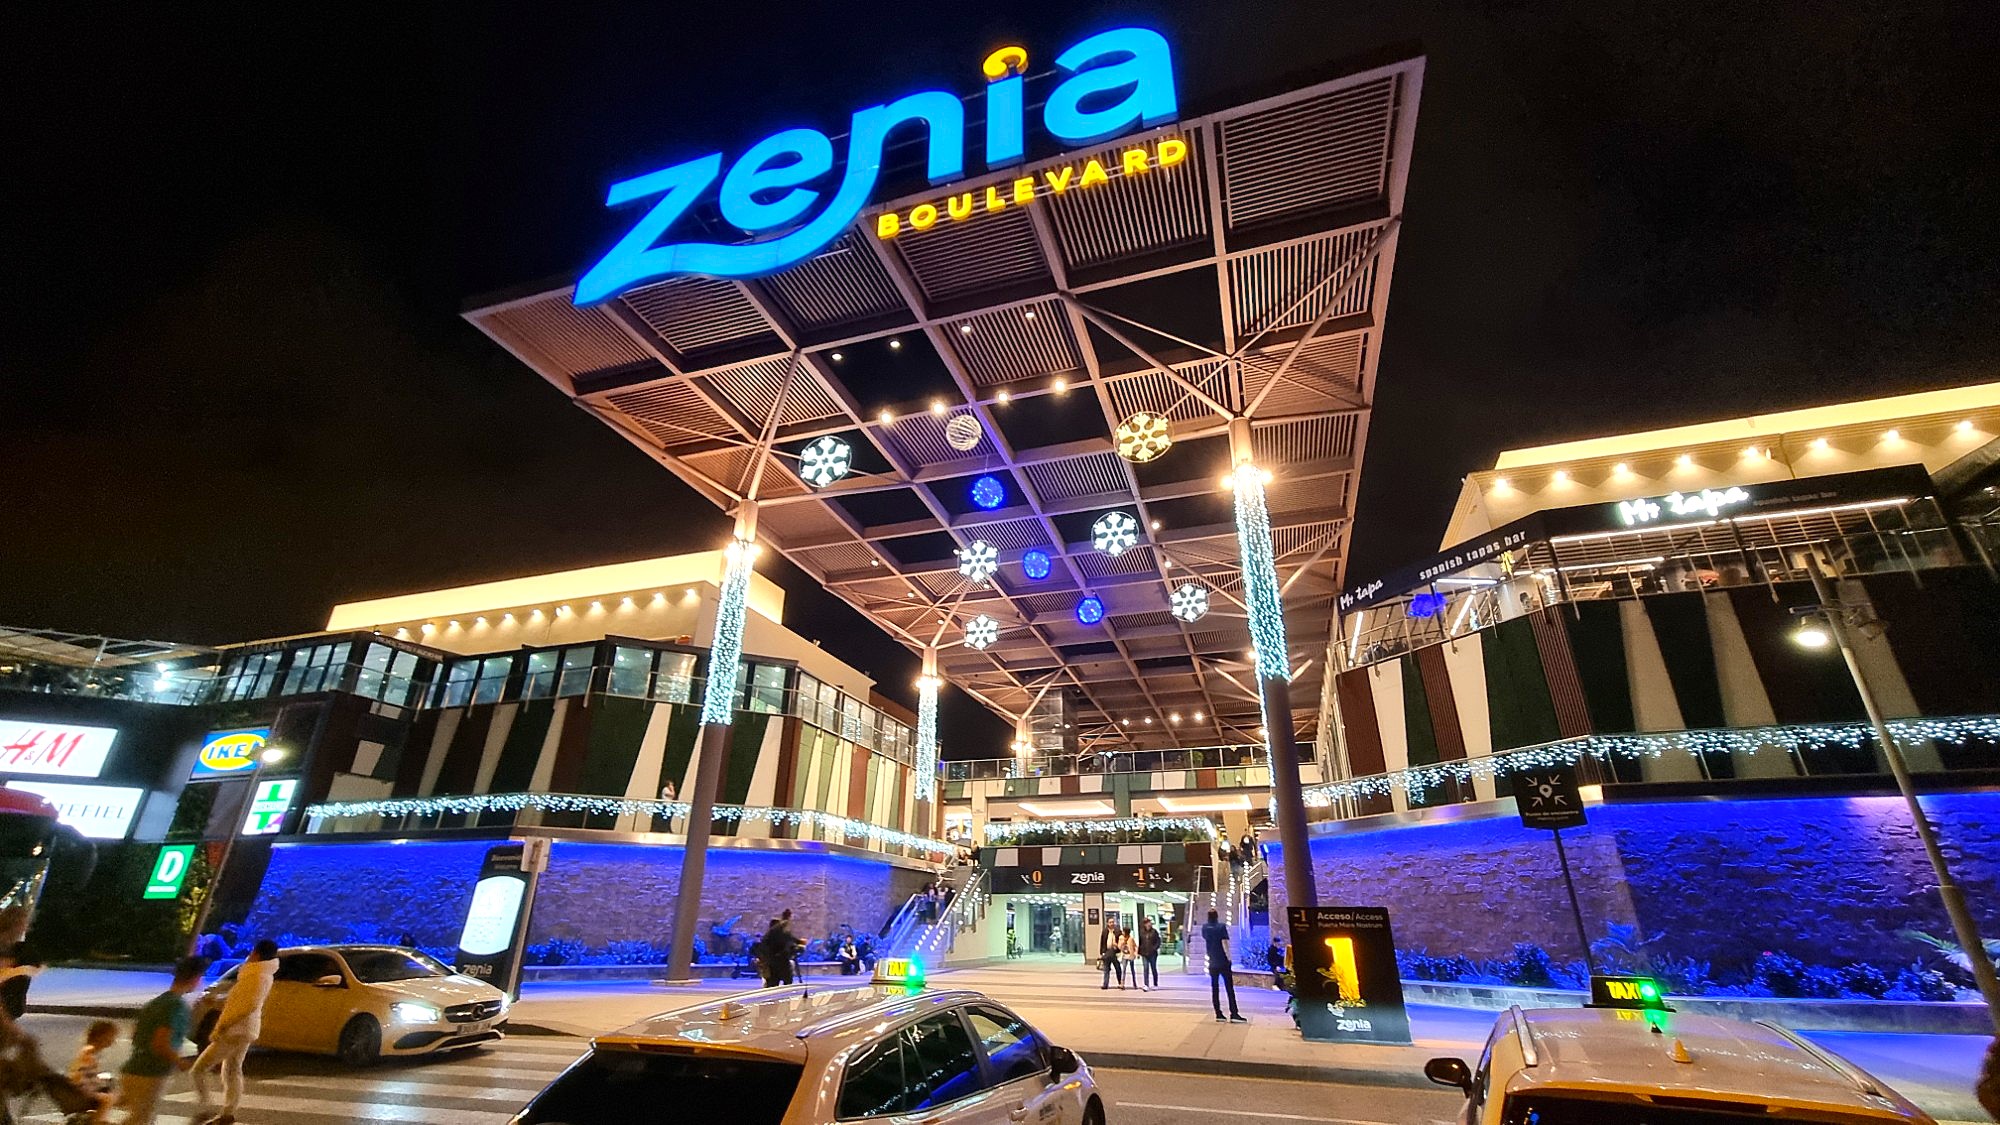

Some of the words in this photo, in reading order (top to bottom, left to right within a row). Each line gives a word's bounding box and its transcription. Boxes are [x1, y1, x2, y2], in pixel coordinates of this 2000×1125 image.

[572, 27, 1178, 305] zenia
[876, 139, 1188, 240] BOULEVARD
[1619, 499, 1660, 525] Mr
[1664, 486, 1749, 516] tapa
[1339, 594, 1354, 610] Mr
[1356, 579, 1384, 599] tapa
[1419, 556, 1463, 580] spanish
[1466, 541, 1500, 562] tapas
[1504, 530, 1526, 547] bar
[0, 729, 85, 768] H&M
[1071, 872, 1105, 885] zenia
[462, 963, 493, 977] zenia
[1606, 981, 1642, 1000] TAXI
[1336, 1019, 1371, 1031] zenia
